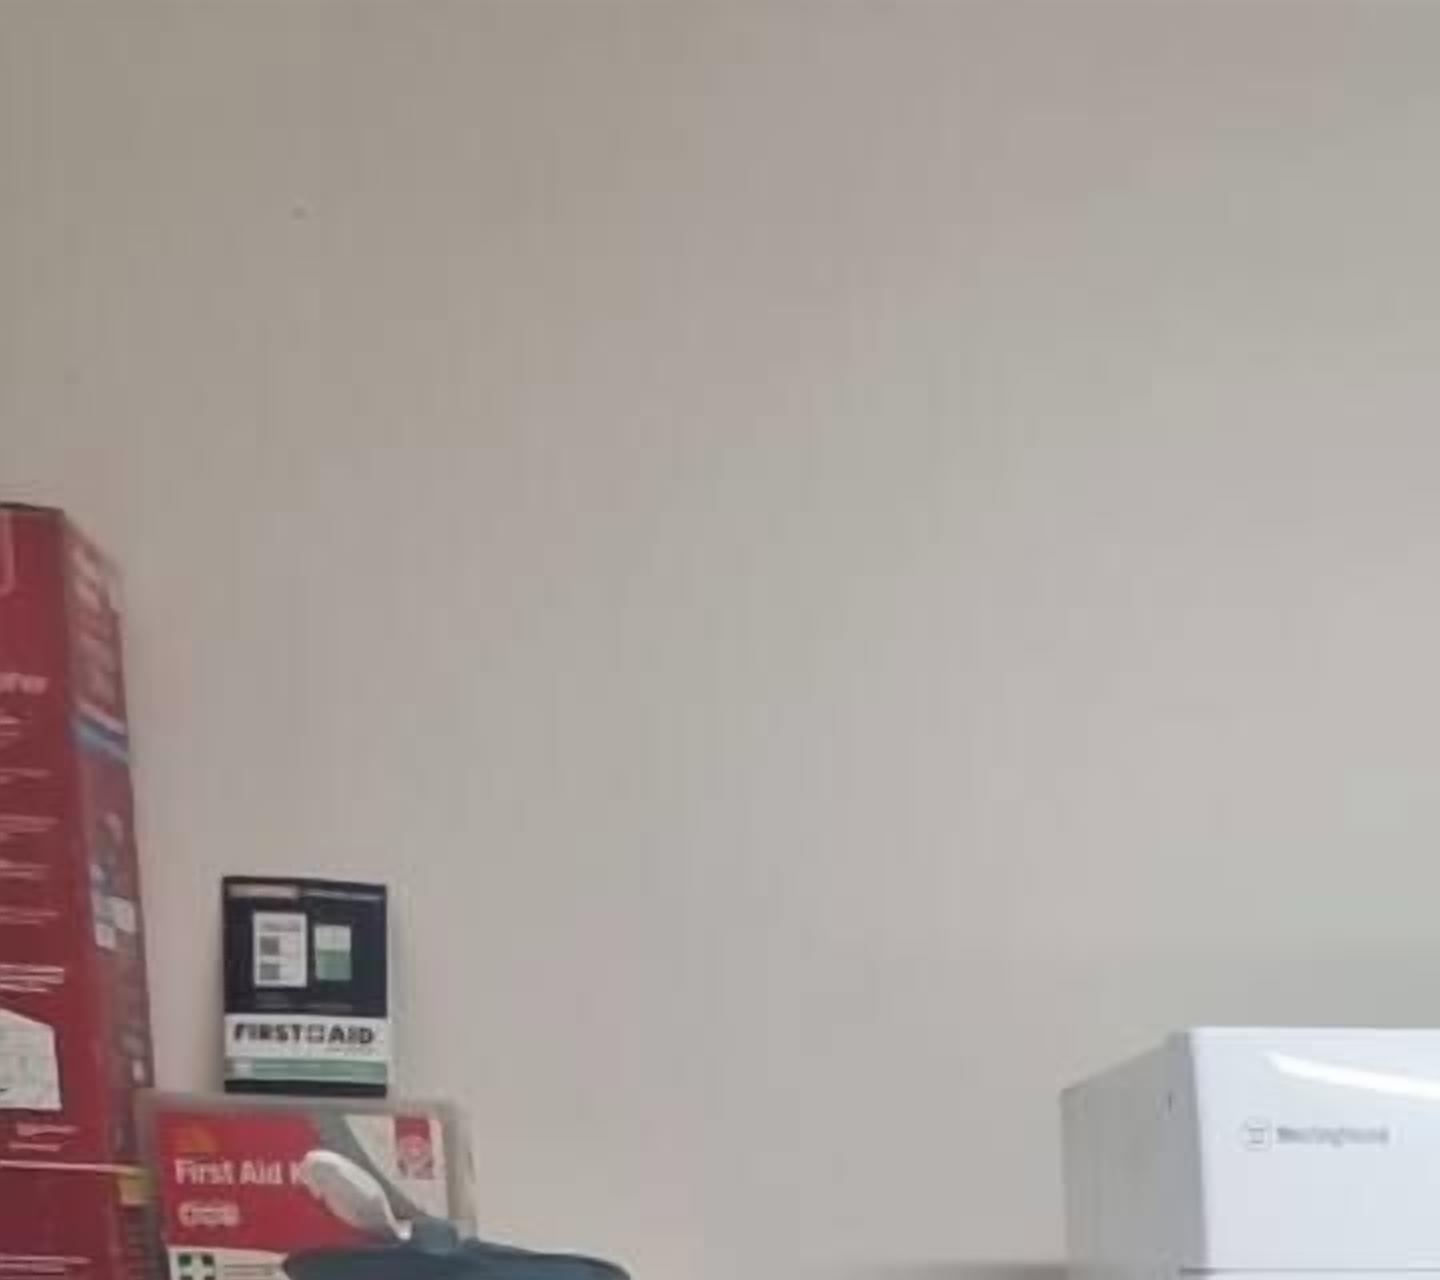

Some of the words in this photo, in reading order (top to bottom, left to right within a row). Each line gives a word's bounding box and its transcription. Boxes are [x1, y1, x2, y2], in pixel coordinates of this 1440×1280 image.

[234, 1023, 303, 1043] FIRST
[328, 1027, 375, 1044] AID
[174, 1158, 232, 1185] First
[240, 1159, 282, 1185] Aid
